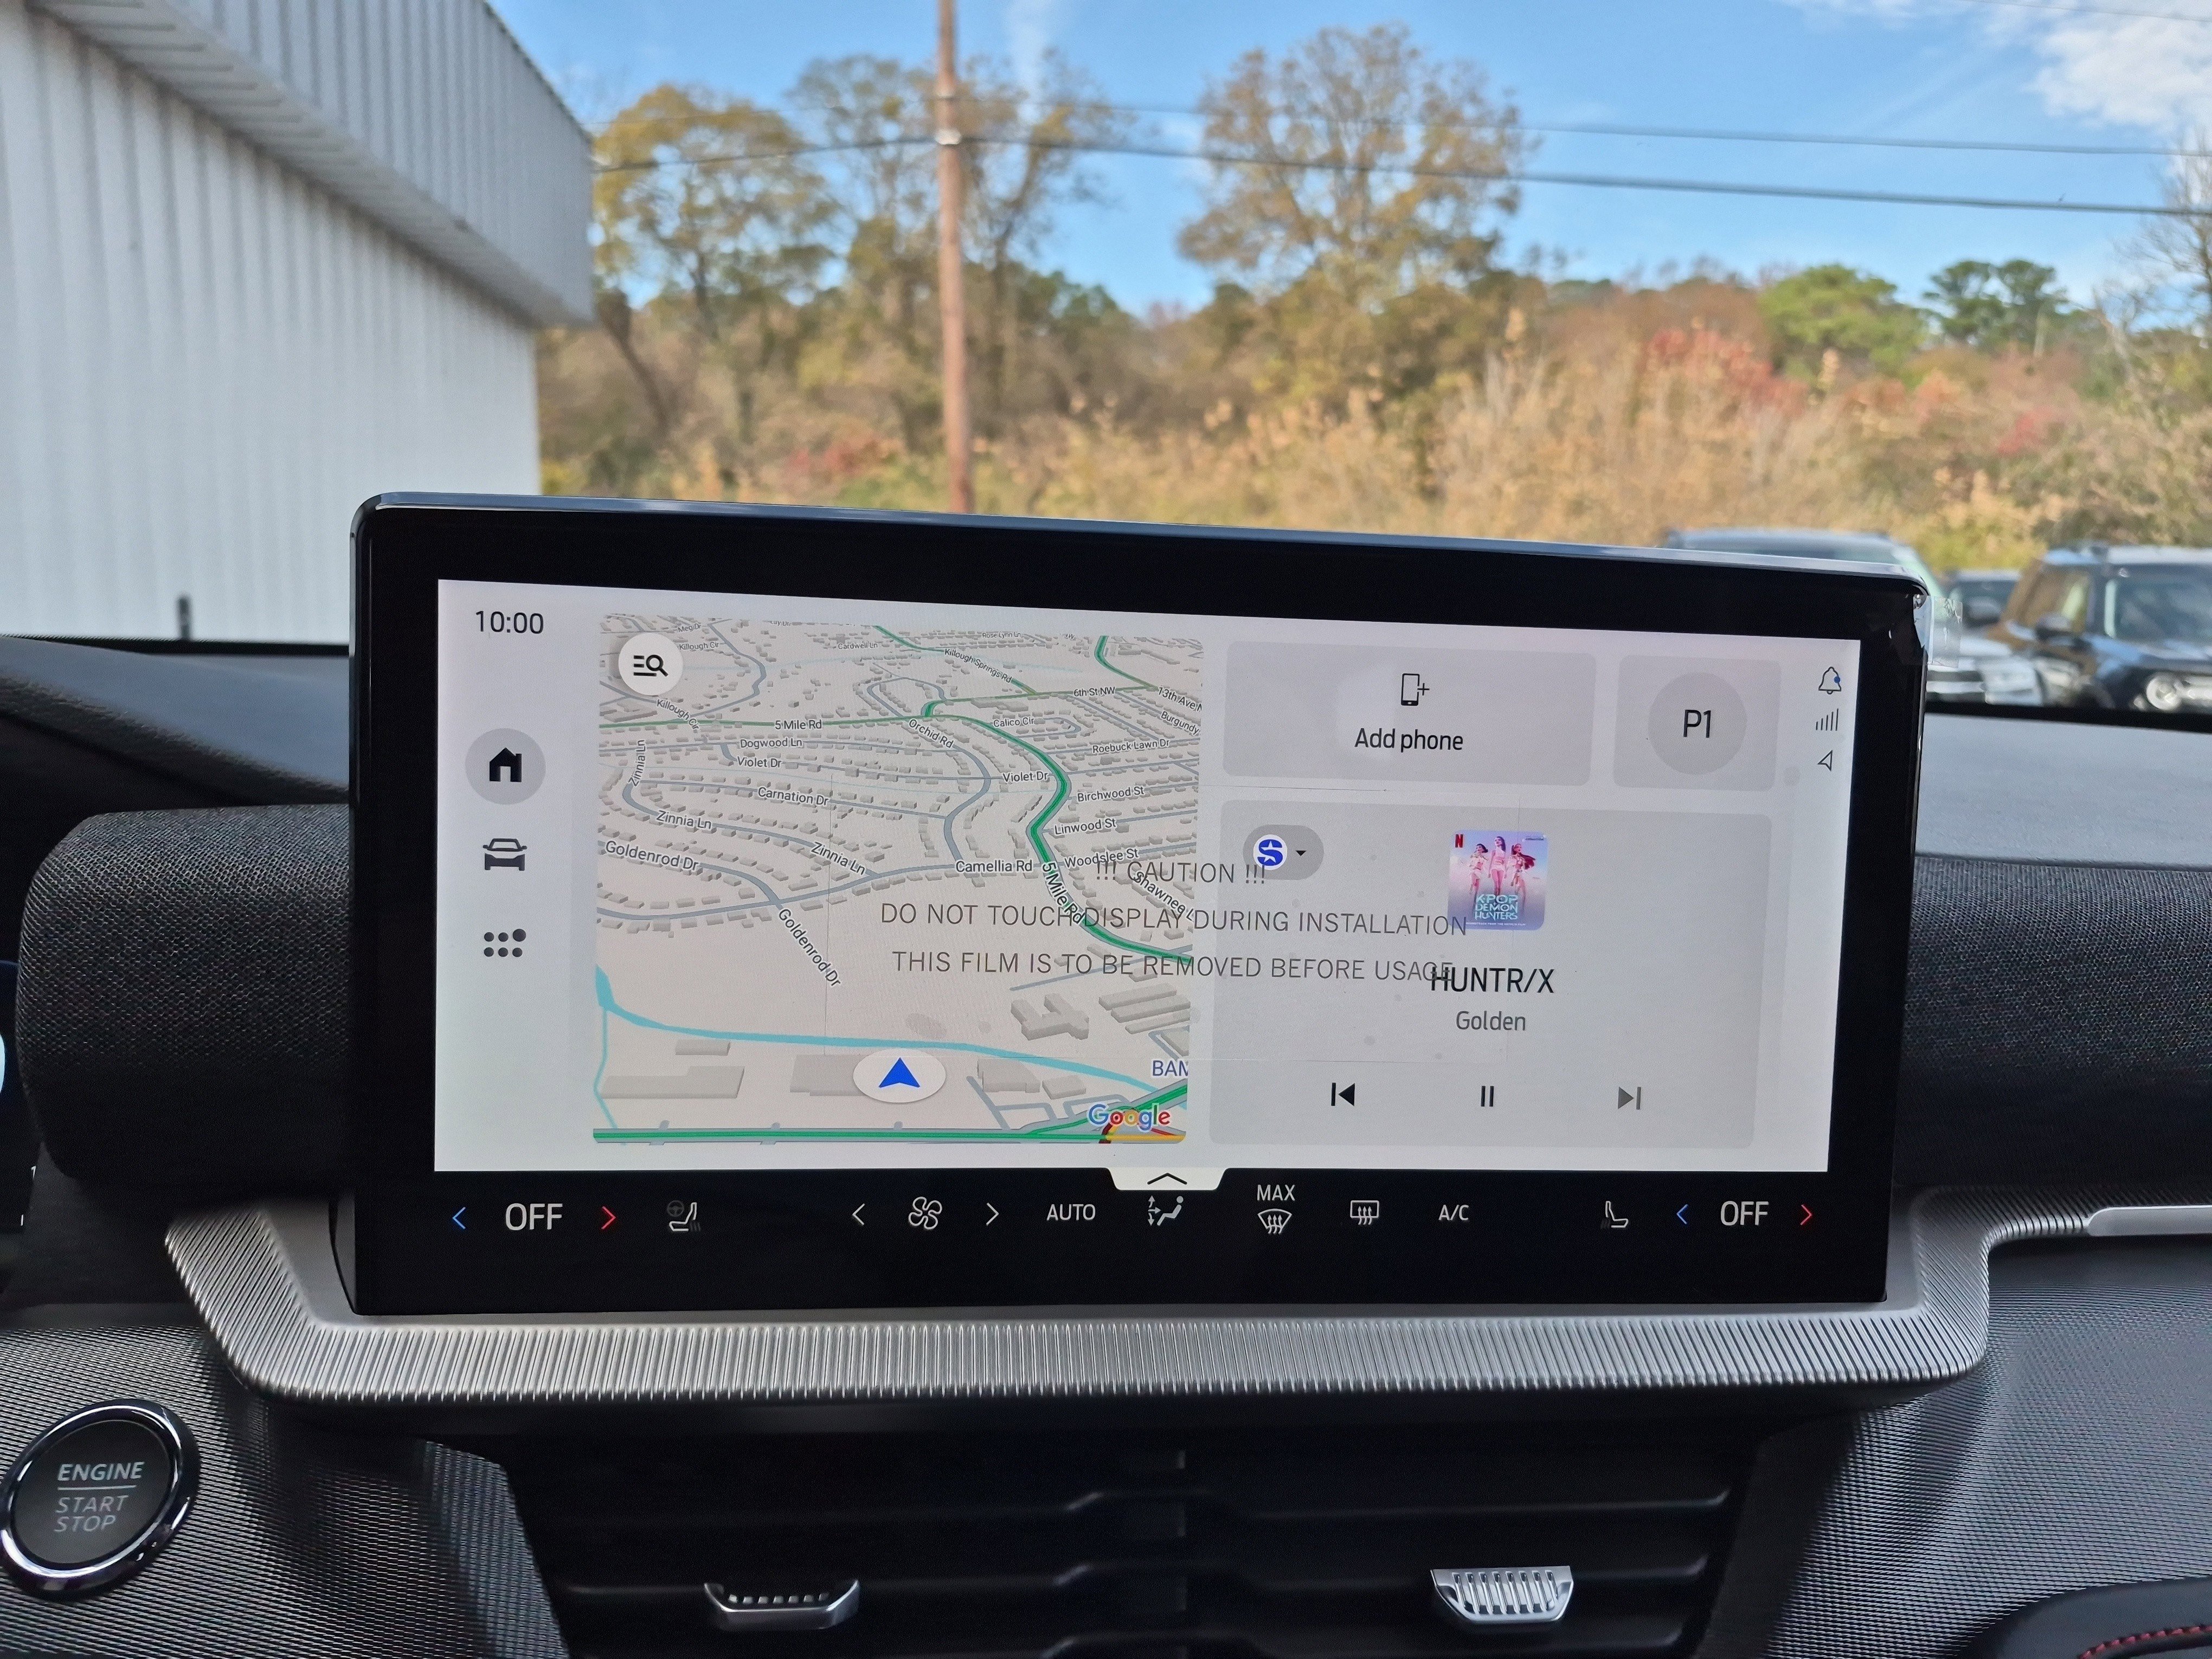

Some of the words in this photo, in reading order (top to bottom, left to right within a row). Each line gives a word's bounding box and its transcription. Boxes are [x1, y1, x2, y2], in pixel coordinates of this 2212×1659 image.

[475, 610, 544, 634] 10:00
[944, 648, 974, 663] Killough
[974, 659, 1001, 678] Springs
[1001, 673, 1012, 683] Rd
[1074, 689, 1086, 697] 6th
[1089, 687, 1099, 696] St
[1100, 686, 1115, 695] NW
[1159, 687, 1177, 702] 13th
[1178, 697, 1195, 709] Ave
[657, 699, 690, 720] Killough
[689, 719, 699, 730] Cir
[775, 721, 782, 730] 5
[784, 720, 806, 730] Mile
[809, 720, 822, 729] Rd
[993, 718, 1020, 727] Calico
[1023, 717, 1034, 725] Cir
[1161, 711, 1199, 735] Burgundy
[1683, 709, 1712, 738] P1
[741, 738, 787, 749] Dogwood
[790, 738, 802, 747] Ln
[909, 719, 940, 741] Orchid
[940, 735, 954, 748] Rd
[1355, 728, 1396, 749] Add
[1401, 728, 1463, 751] phone
[1092, 743, 1130, 754] Roebuck
[1134, 741, 1158, 750] Lawn
[1160, 739, 1169, 747] Dr
[629, 756, 646, 787] Zinnia
[638, 740, 646, 754] Ln
[737, 757, 767, 768] Violet
[770, 758, 782, 767] Dr
[1002, 772, 1033, 782] Violet
[1036, 771, 1048, 780] Dr
[758, 788, 813, 803] Carnation
[816, 795, 829, 806] Dr
[1077, 787, 1131, 802] Birchwood
[1134, 786, 1144, 795] St
[656, 811, 694, 826] Zinnia
[698, 819, 711, 829] Ln
[1054, 821, 1102, 835] Linwood
[1104, 818, 1116, 829] St
[606, 841, 679, 867] Goldenrod
[683, 857, 698, 871] Dr
[811, 843, 847, 867] Zinnia
[850, 860, 865, 874] Ln
[956, 860, 1012, 872] Camellia
[1016, 860, 1032, 872] Rd
[1064, 851, 1123, 869] Woodslee
[1127, 848, 1139, 859] St
[1043, 862, 1057, 873] 5
[1097, 861, 1115, 880] !!!
[1127, 861, 1234, 884] CAUTION
[1245, 864, 1265, 884] !!!
[1046, 873, 1068, 908] Mile
[1134, 871, 1186, 914] Shawnee
[1063, 903, 1085, 924] Rd
[1475, 902, 1518, 913] DEMON
[1475, 911, 1518, 921] HUNTERS
[882, 903, 916, 923] DO
[928, 904, 978, 924] NOT
[988, 905, 1072, 926] TOUCH
[1085, 908, 1182, 929] DISPLAY
[1194, 910, 1288, 932] DURING
[1299, 912, 1467, 935] INSTALLATION
[779, 909, 829, 971] Goldenrod
[825, 972, 840, 987] Dr
[892, 951, 950, 972] THIS
[961, 953, 1018, 972] FILM
[1030, 954, 1051, 973] IS
[1061, 954, 1092, 974] TO
[1103, 955, 1133, 974] BE
[1143, 956, 1261, 978] REMOVED
[1271, 958, 1365, 980] BEFORE
[1374, 960, 1454, 981] USAGE
[1430, 967, 1554, 993] HUNTR/X
[1456, 1011, 1526, 1031] Golden
[1089, 1103, 1171, 1131] Google
[1257, 1184, 1295, 1202] MAX
[505, 1203, 563, 1231] OFF
[1046, 1203, 1096, 1221] AUTO
[1438, 1204, 1469, 1222] A/C
[1720, 1201, 1769, 1227] OFF
[57, 1461, 145, 1481] ENGINE
[55, 1495, 129, 1514] START
[55, 1515, 116, 1533] STOP
